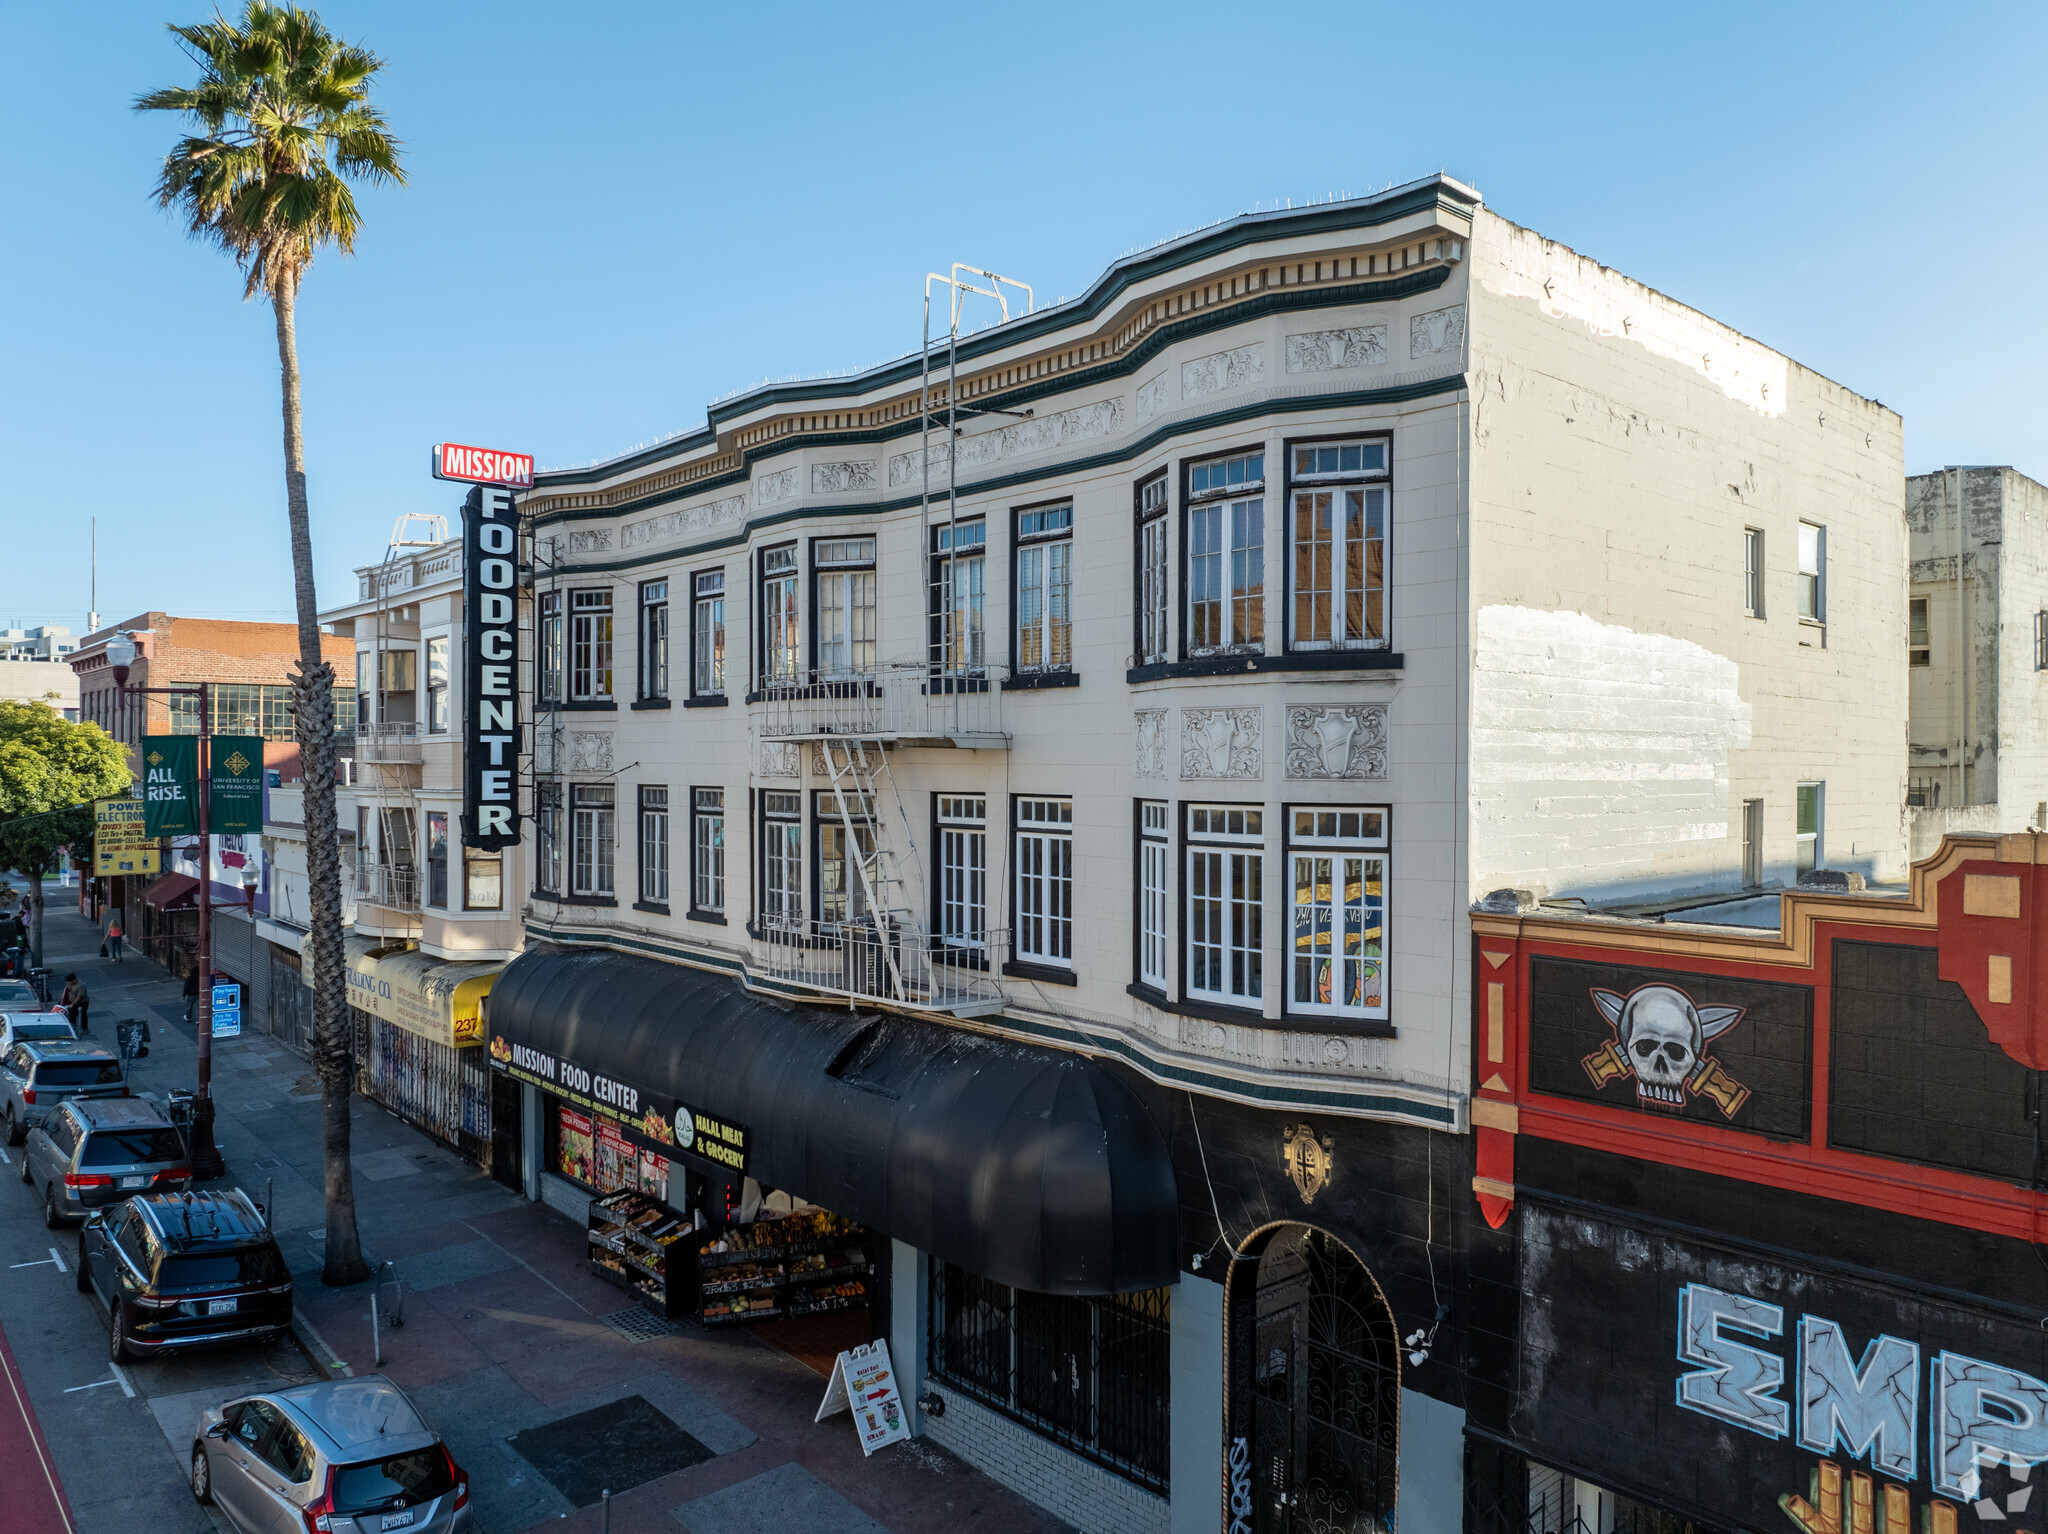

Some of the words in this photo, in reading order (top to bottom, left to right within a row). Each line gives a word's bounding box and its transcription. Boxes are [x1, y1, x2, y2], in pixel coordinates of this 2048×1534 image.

[446, 446, 530, 484] MISSION
[147, 768, 176, 783] ALL
[97, 812, 145, 822] ELECTRON
[108, 802, 144, 811] POWE
[126, 822, 146, 830] CAMCO
[344, 966, 376, 993] TRADING
[455, 1017, 478, 1033] 237
[513, 1043, 555, 1079] MISSION
[561, 1062, 590, 1093] FOOD
[593, 1075, 639, 1113] CENTER
[696, 1114, 721, 1138] HALAL
[721, 1124, 743, 1148] MEAT
[697, 1136, 705, 1154] &
[705, 1140, 744, 1169] GROCERY
